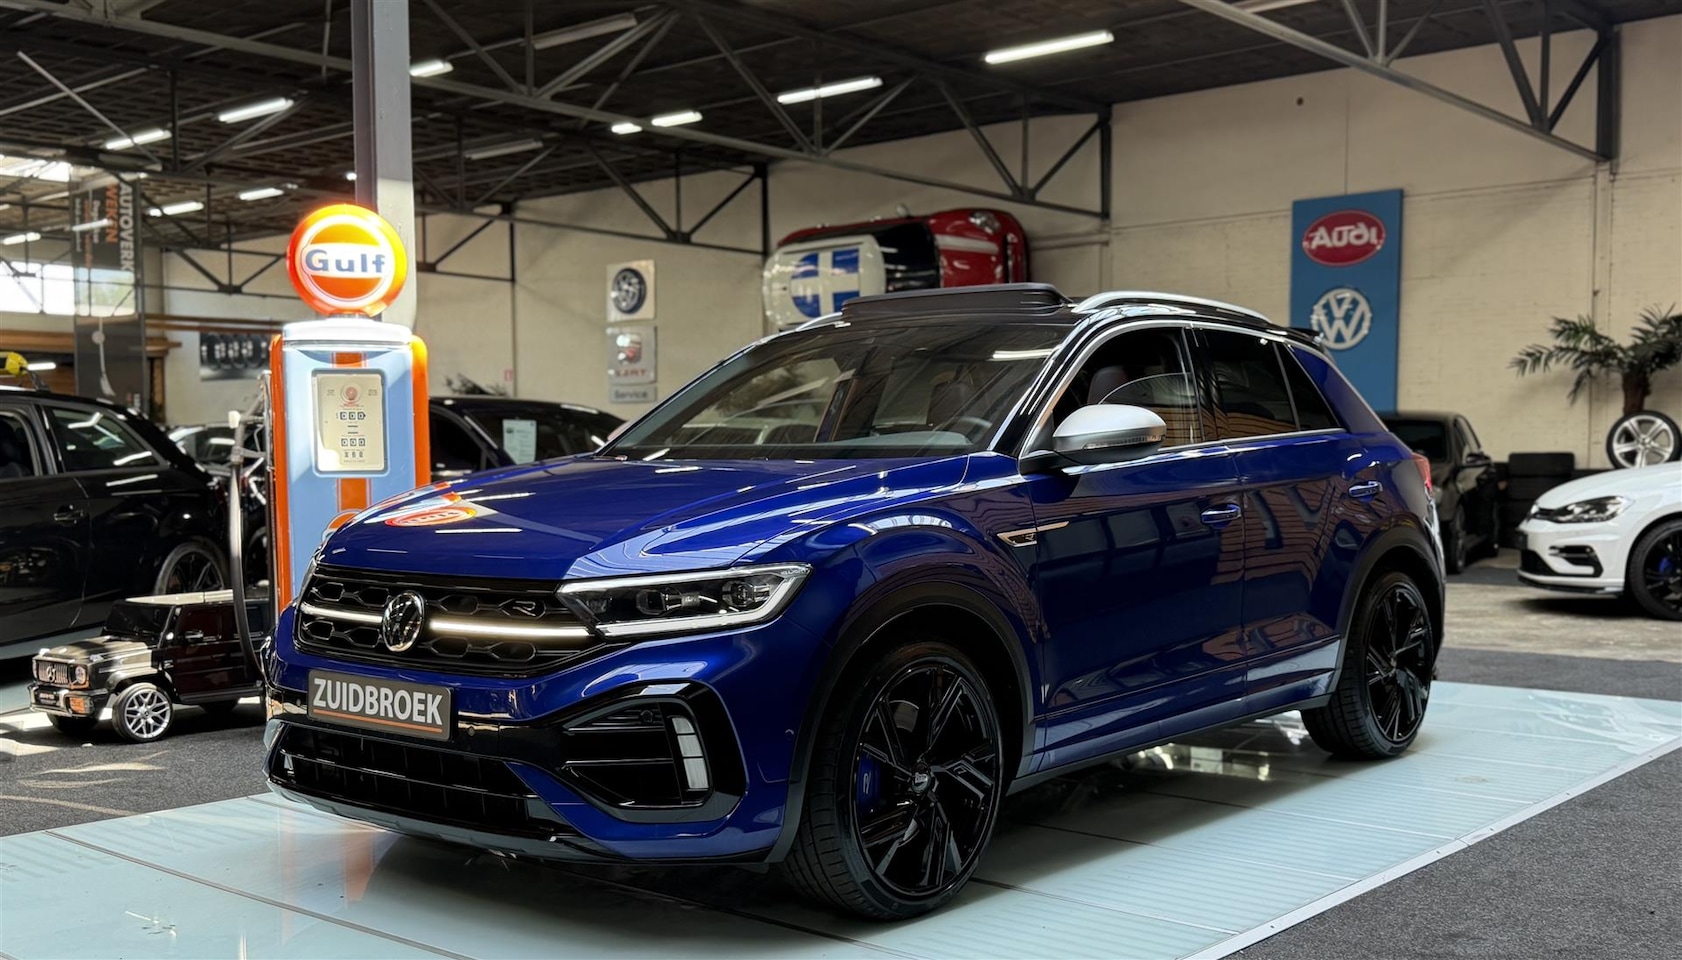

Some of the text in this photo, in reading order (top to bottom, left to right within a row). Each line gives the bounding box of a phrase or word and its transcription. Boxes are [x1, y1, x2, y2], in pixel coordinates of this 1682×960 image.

[119, 182, 135, 272] AUTOVERK
[305, 249, 386, 273] Gulf
[312, 677, 443, 726] ZUIDBROEK
